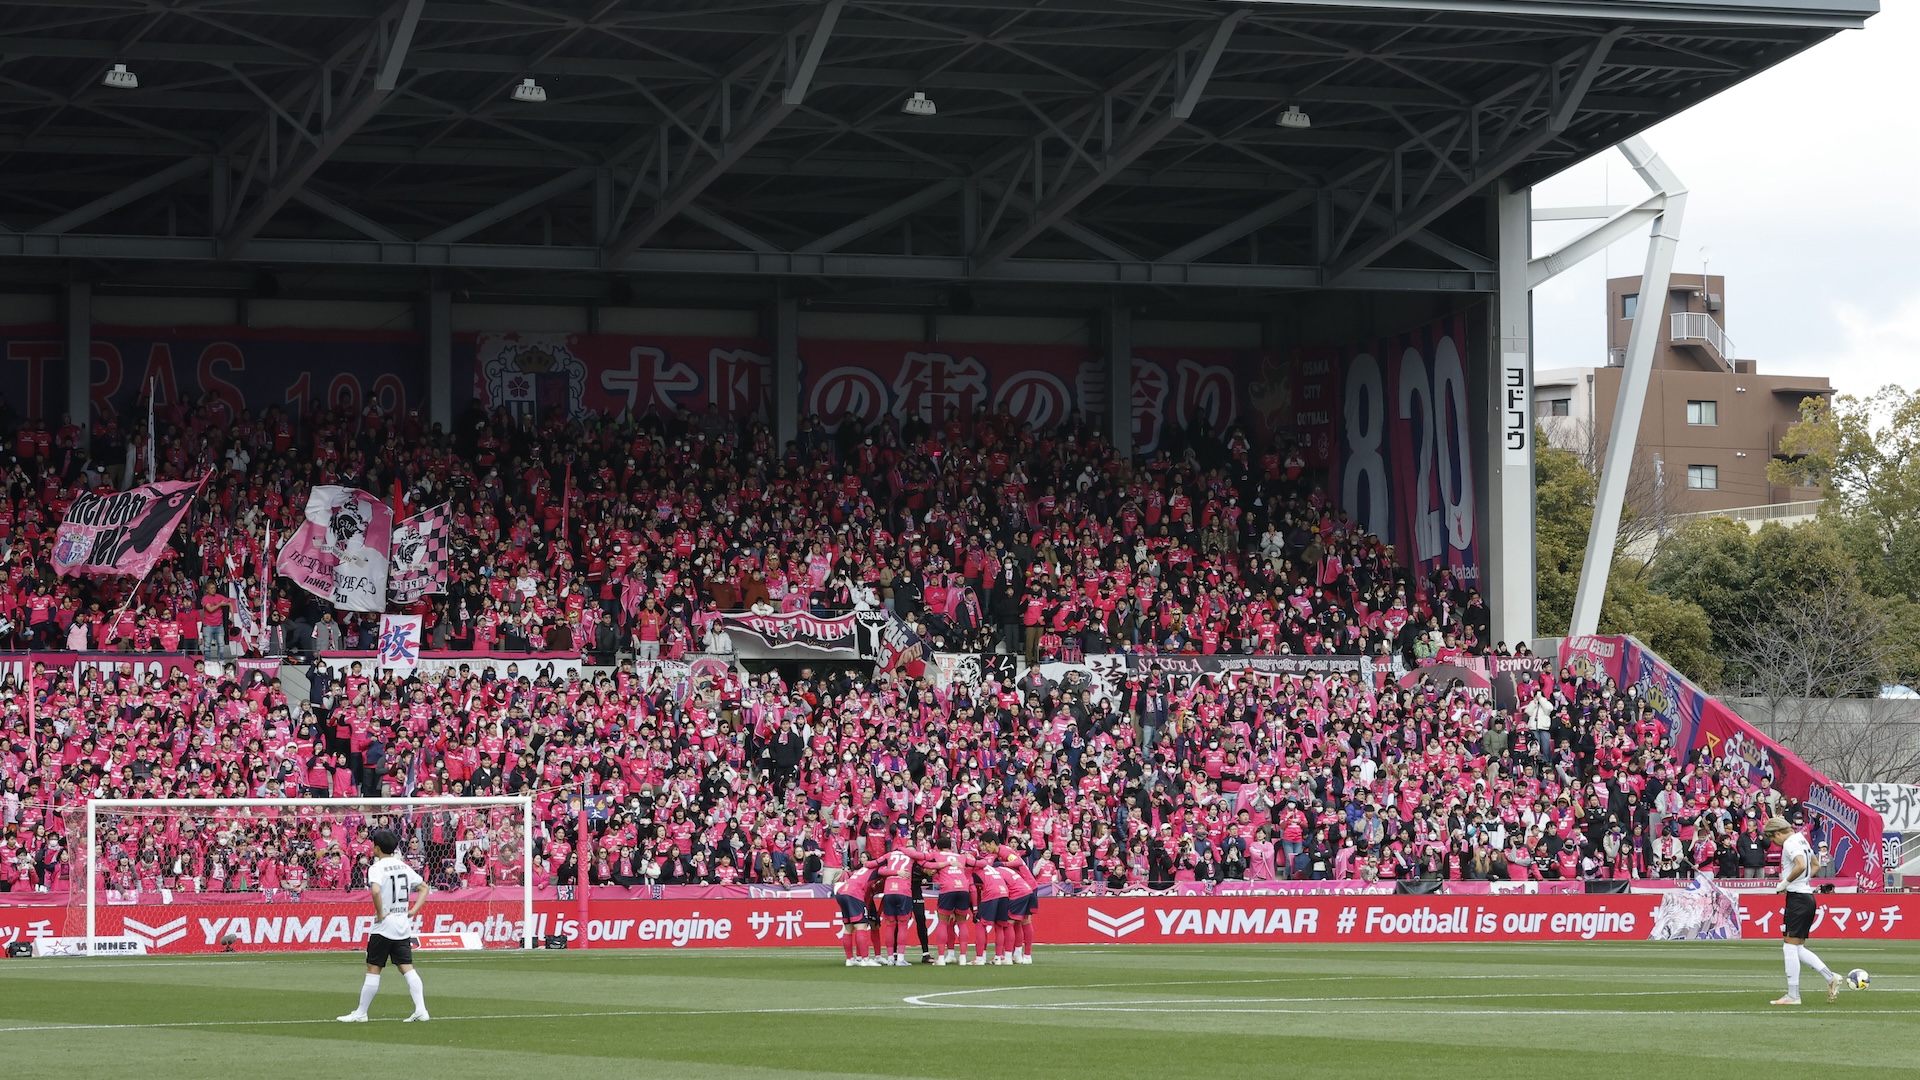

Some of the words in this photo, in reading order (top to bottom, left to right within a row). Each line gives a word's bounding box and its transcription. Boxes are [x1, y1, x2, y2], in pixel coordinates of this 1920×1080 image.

[1303, 359, 1330, 376] OSAKA
[1303, 385, 1321, 399] CITY
[1506, 368, 1525, 450] ヨドコウ
[1297, 411, 1330, 426] OOTBALL
[1399, 336, 1474, 562] 20
[856, 610, 885, 621] OSAK
[801, 619, 855, 642] DIEM
[1589, 638, 1615, 658] CEREZO
[1138, 657, 1204, 673] SAKURA
[1250, 659, 1297, 671] HISTORY
[1299, 660, 1328, 671] FROM
[889, 855, 911, 871] 77
[389, 873, 409, 904] 13
[198, 916, 374, 945] YANMAR
[433, 912, 548, 942] Football
[553, 912, 579, 942] is
[587, 918, 635, 942] our
[637, 911, 732, 948] engine
[1154, 908, 1320, 936] YANMAR
[1336, 906, 1357, 934] #
[1365, 906, 1469, 934] Football
[1475, 906, 1497, 934] is
[1502, 911, 1547, 934] our
[1550, 905, 1636, 940] engine
